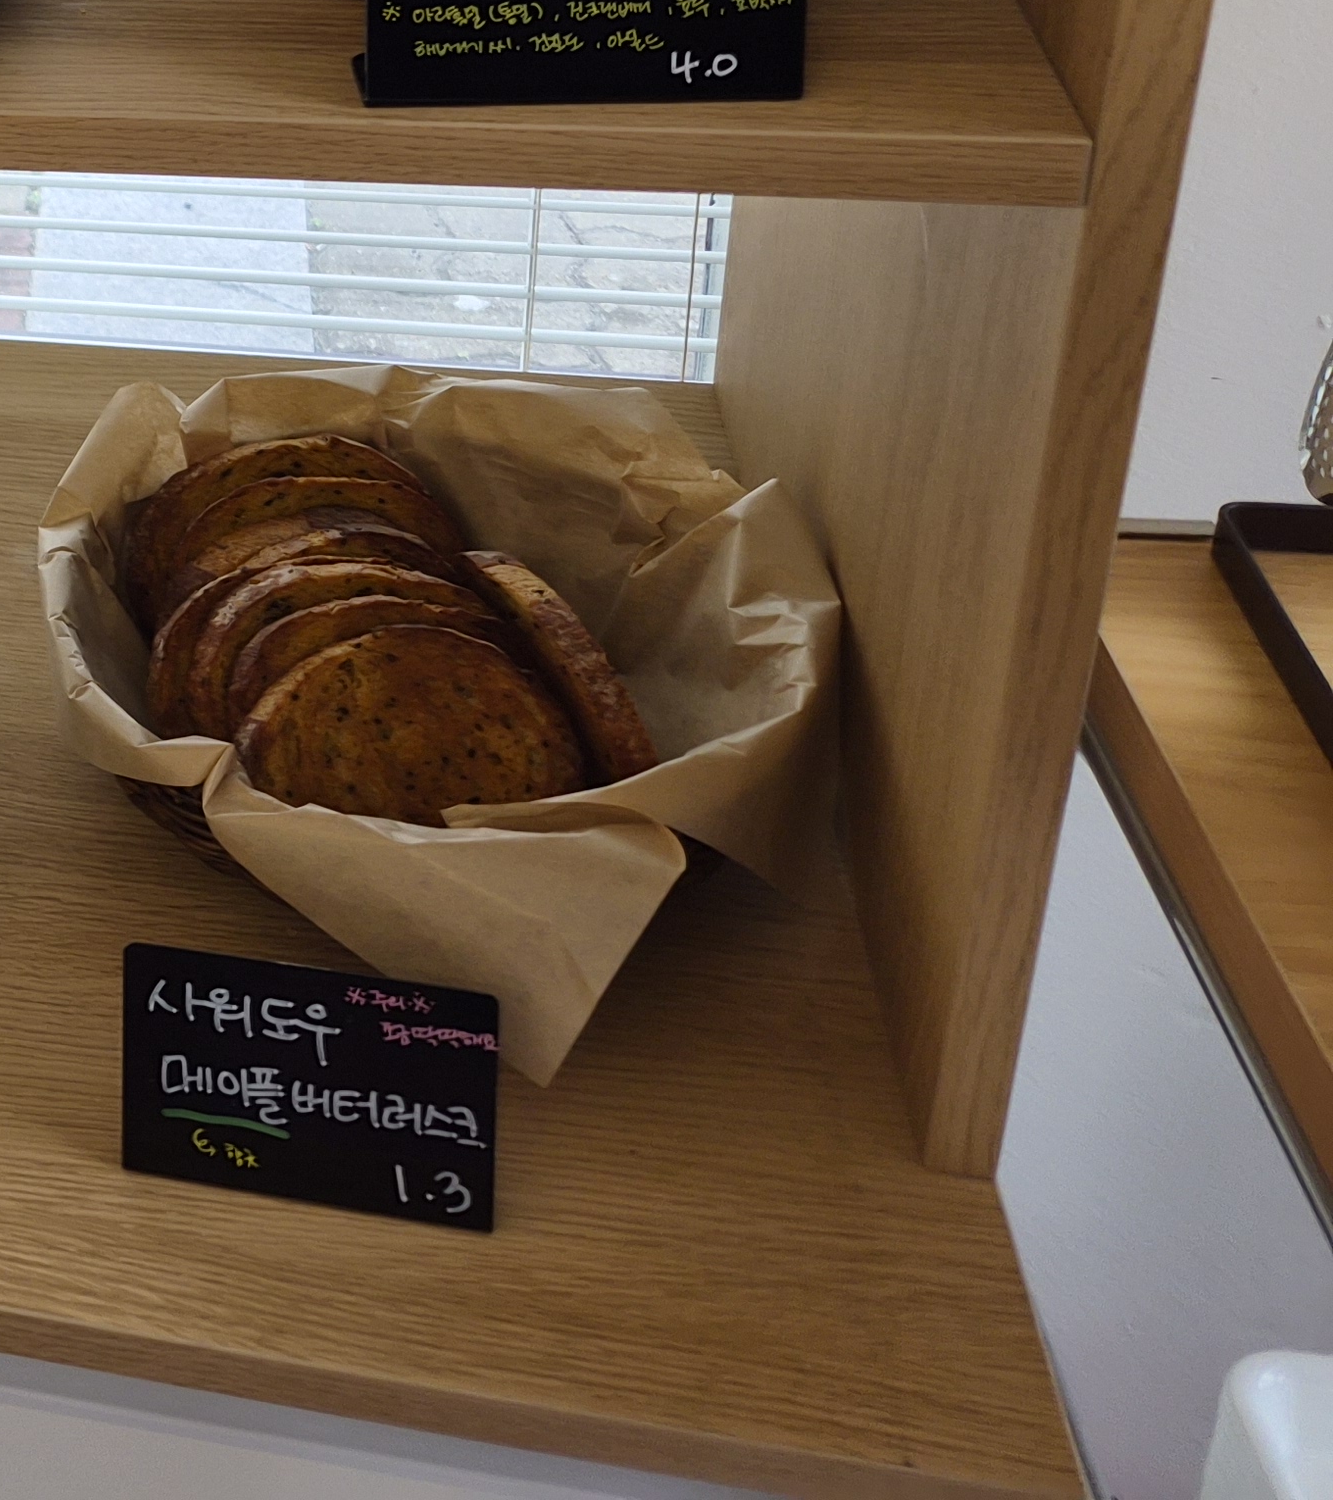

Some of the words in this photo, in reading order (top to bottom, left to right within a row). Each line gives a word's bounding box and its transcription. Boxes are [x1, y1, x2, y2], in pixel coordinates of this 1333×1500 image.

[670, 49, 739, 84] 4.0
[148, 979, 342, 1067] 사워도우
[393, 1164, 472, 1214] 1.3
